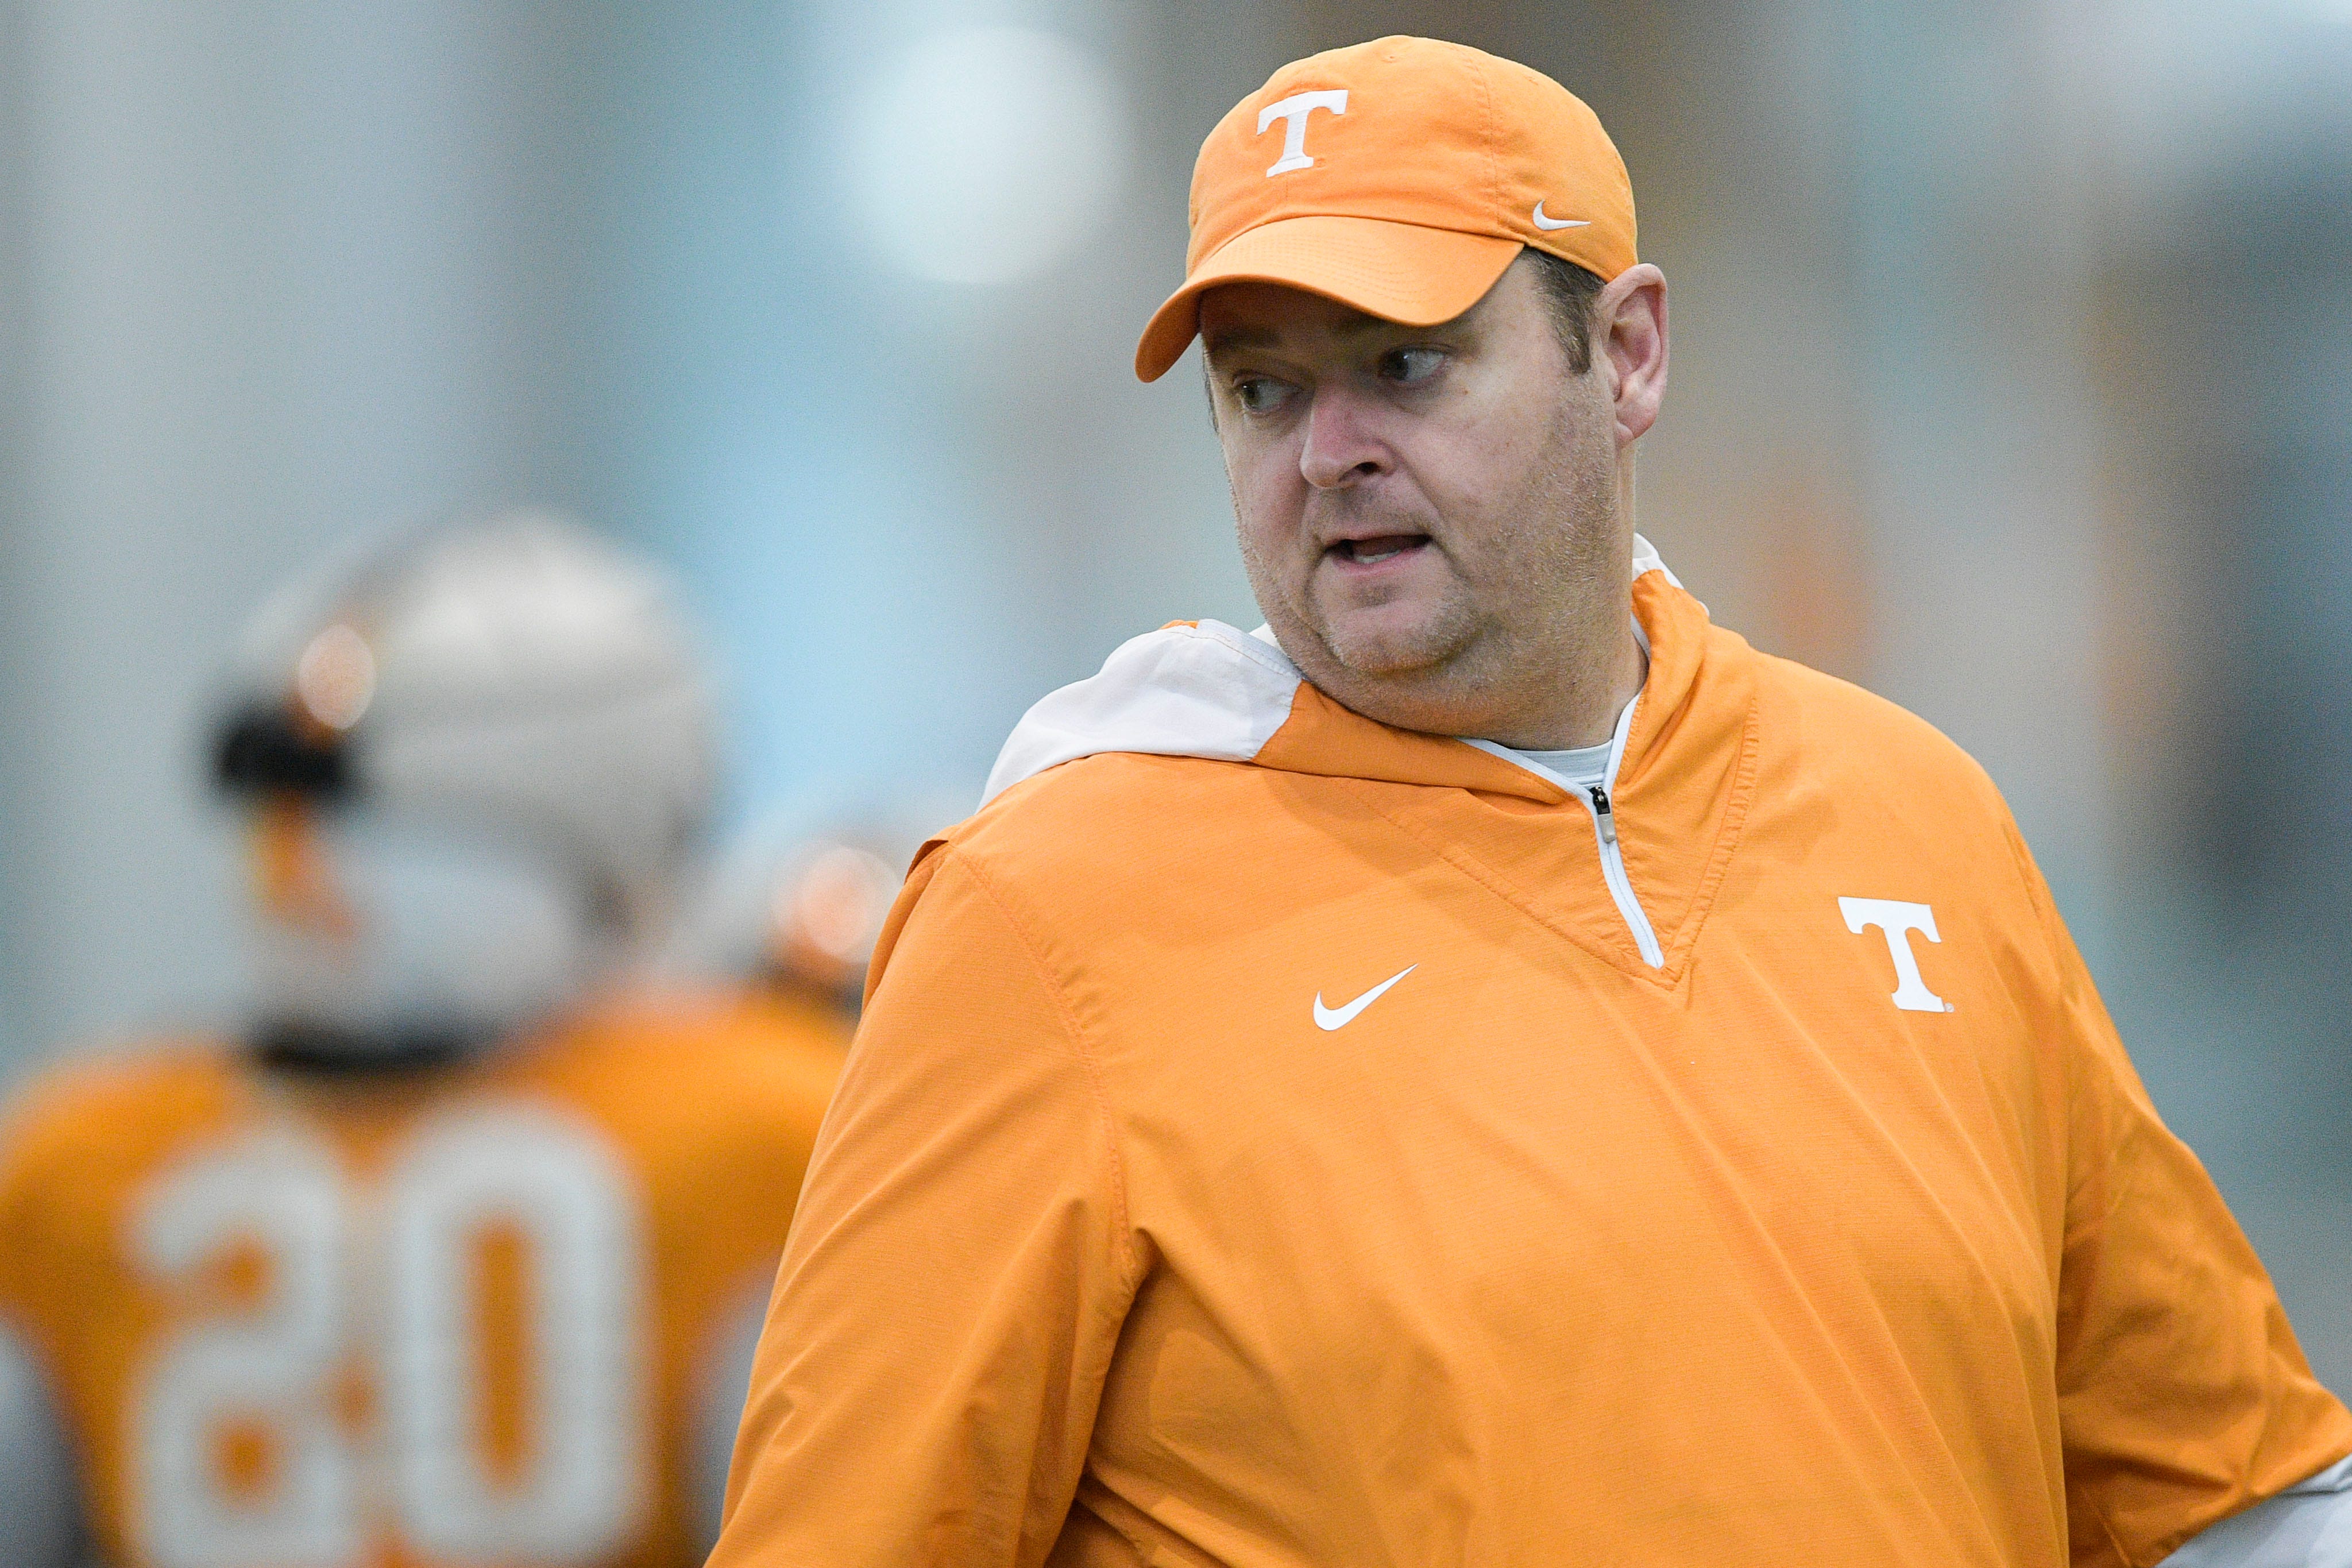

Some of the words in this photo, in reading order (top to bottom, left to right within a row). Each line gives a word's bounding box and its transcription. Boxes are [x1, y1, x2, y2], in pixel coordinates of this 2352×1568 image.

[1257, 89, 1349, 177] T
[1837, 895, 1945, 1013] T
[122, 1091, 646, 1568] 20
